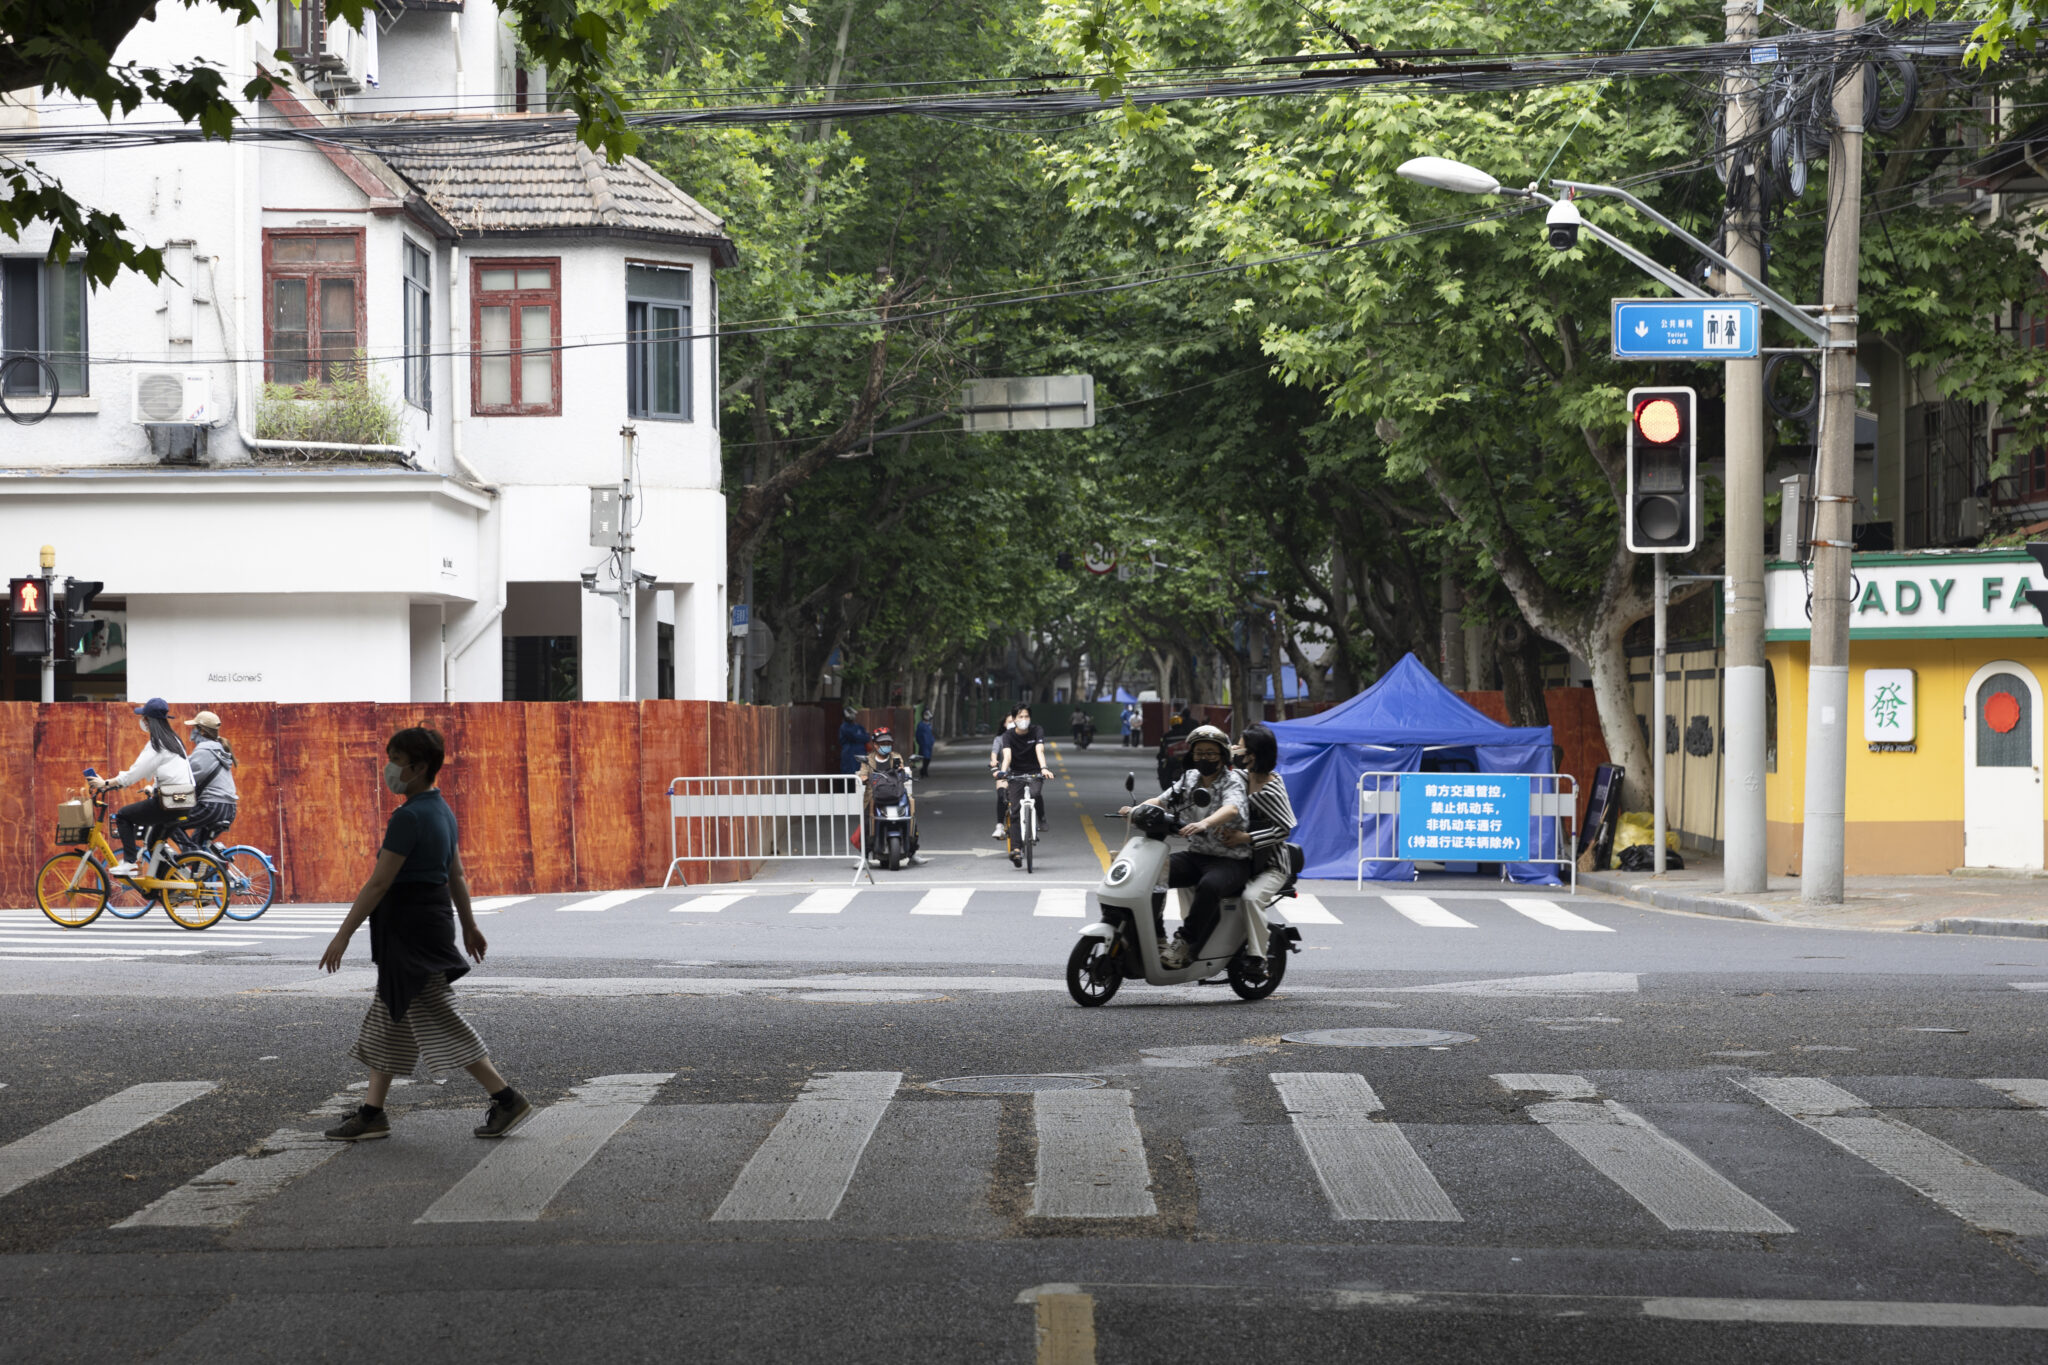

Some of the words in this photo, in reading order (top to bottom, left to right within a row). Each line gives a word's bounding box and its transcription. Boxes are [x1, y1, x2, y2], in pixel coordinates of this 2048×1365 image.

[1857, 578, 1955, 614] ADY
[208, 672, 227, 682] Atlas
[1870, 682, 1907, 728] 發
[1425, 784, 1506, 798] 前方交通管控，
[1431, 801, 1500, 815] 禁止机动车，
[1426, 818, 1502, 832] 非机动车通行
[1407, 835, 1520, 850] （持通行证车辆除外）
